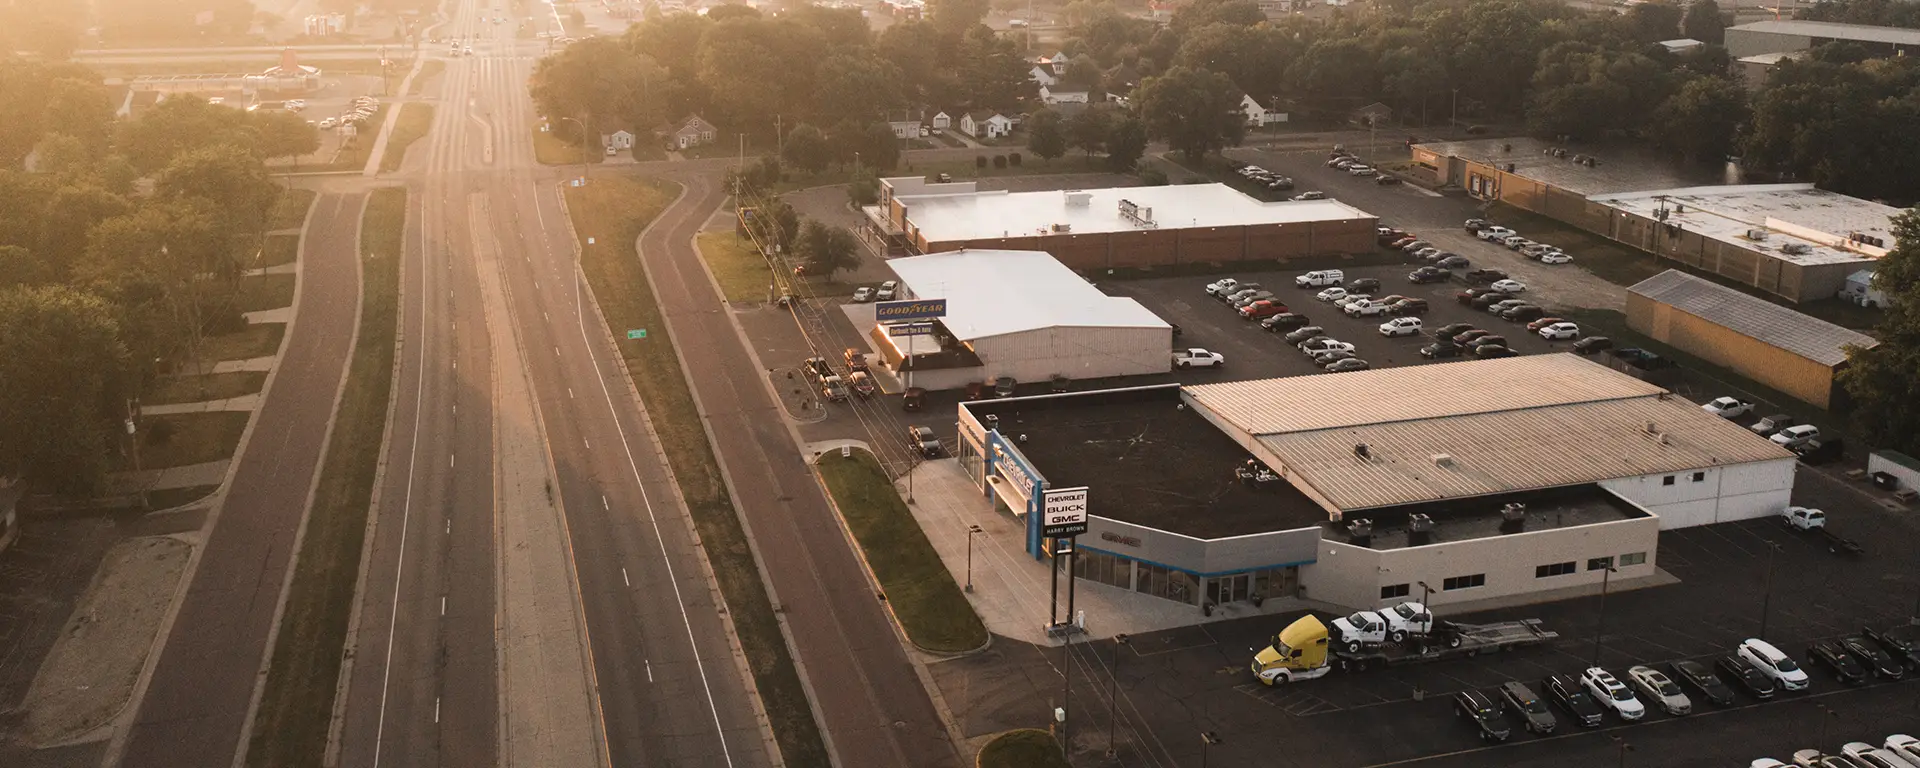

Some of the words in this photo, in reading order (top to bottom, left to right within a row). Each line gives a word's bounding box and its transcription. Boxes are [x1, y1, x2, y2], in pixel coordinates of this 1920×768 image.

[879, 304, 943, 315] GOODYEAR
[1047, 494, 1085, 503] CHEVROLET
[1047, 504, 1084, 513] BUICK
[1052, 515, 1080, 523] GMC
[1101, 531, 1141, 547] GMC
